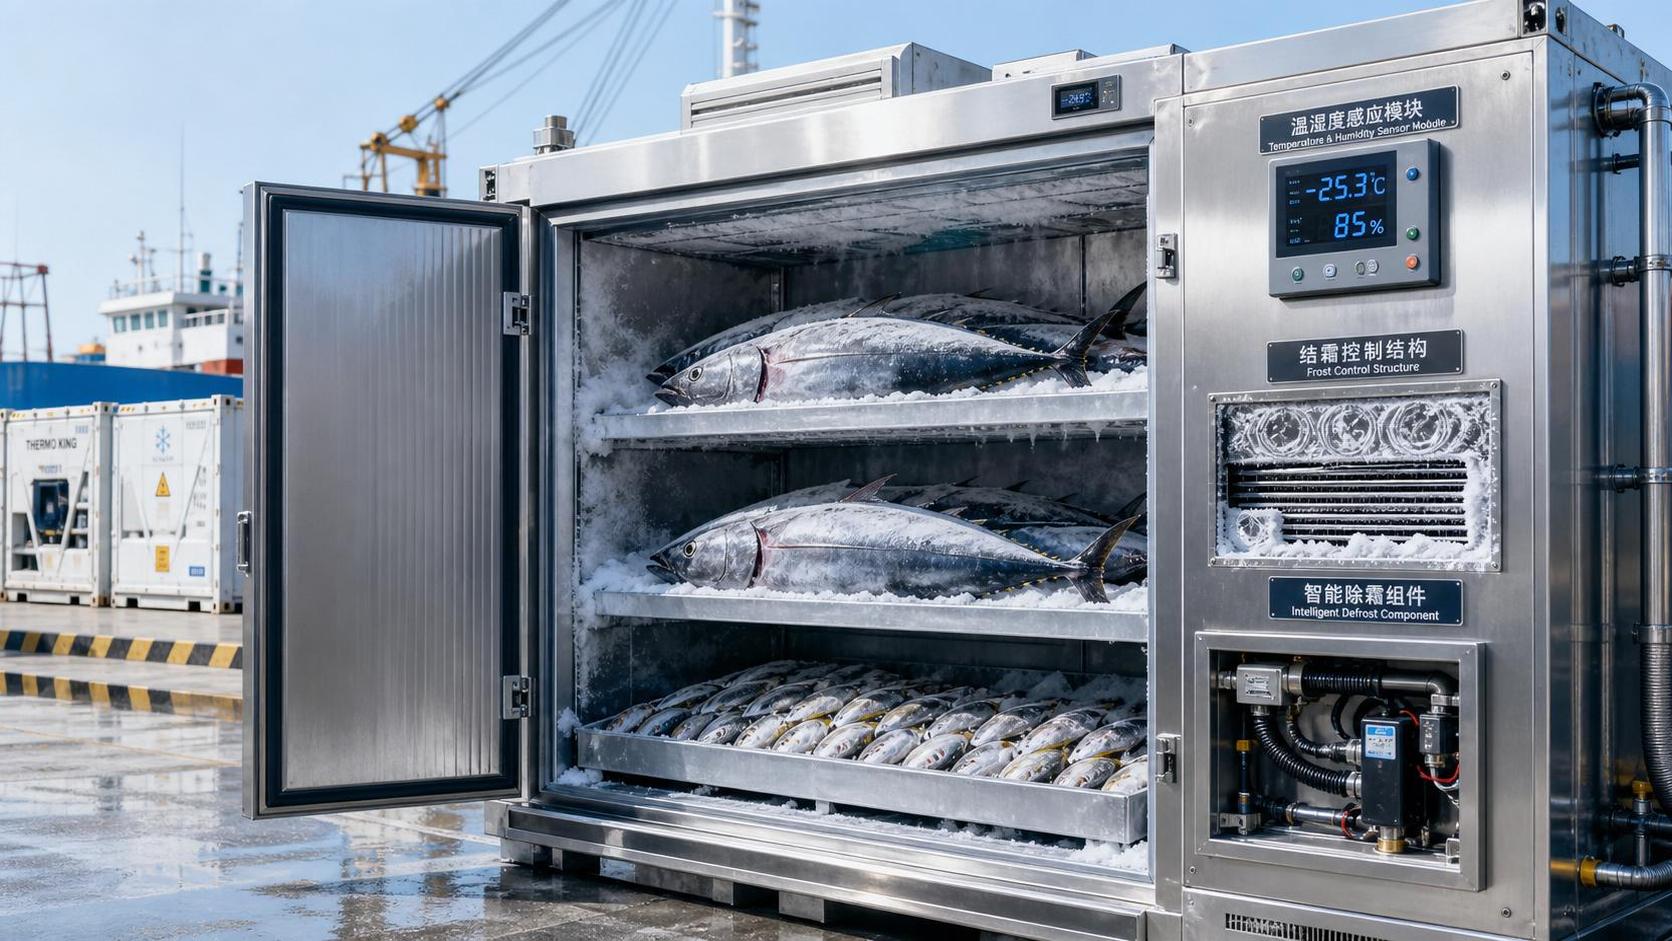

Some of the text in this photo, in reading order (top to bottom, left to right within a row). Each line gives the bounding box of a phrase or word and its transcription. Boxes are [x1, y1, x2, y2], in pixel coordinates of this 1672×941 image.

[1291, 97, 1423, 136] 温湿度感应模块
[1377, 124, 1410, 135] Sensor
[1299, 337, 1427, 364] 结霜控制结构
[1307, 363, 1420, 377] Frost Control Structure
[26, 437, 77, 450] THERMO KING
[1304, 582, 1426, 607] 智能除霜组件
[1291, 606, 1439, 621] Intelligent Defrost Component
